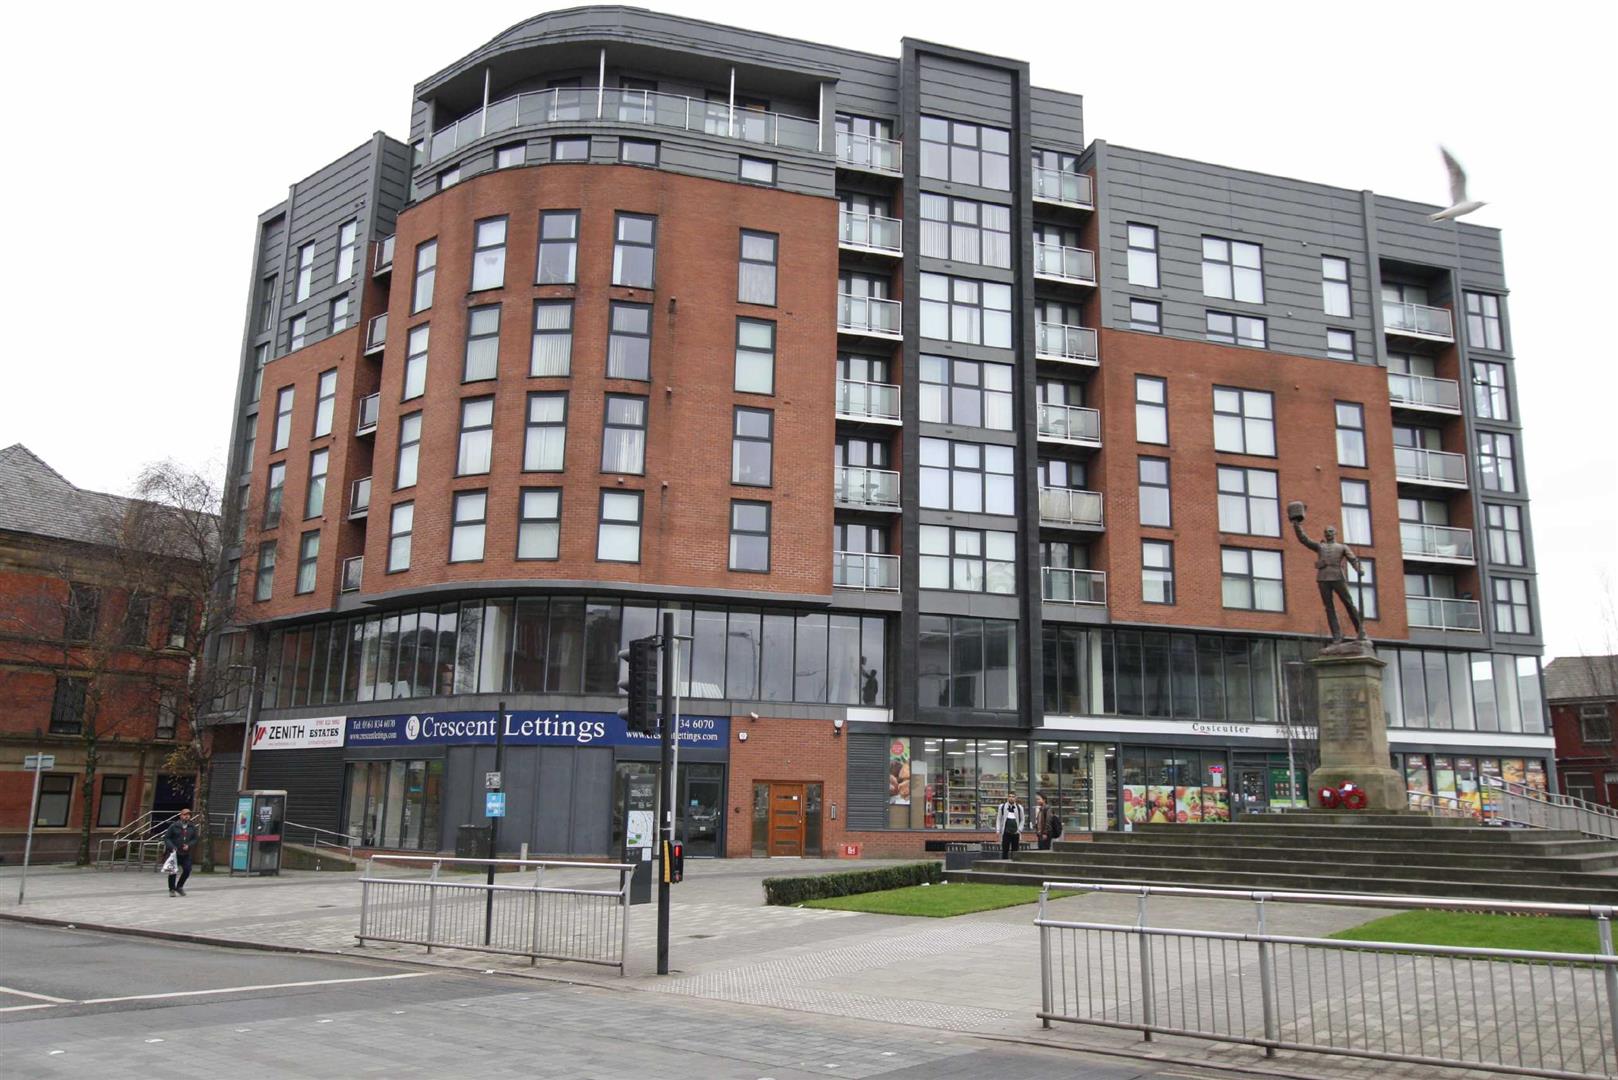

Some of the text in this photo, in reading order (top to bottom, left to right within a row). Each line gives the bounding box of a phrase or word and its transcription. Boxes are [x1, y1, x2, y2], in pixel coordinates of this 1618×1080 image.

[422, 714, 605, 743] Crescent Lettings
[692, 719, 714, 729] 6070
[1192, 722, 1251, 734] Costcutter
[269, 725, 339, 740] ZENITH ESTATES
